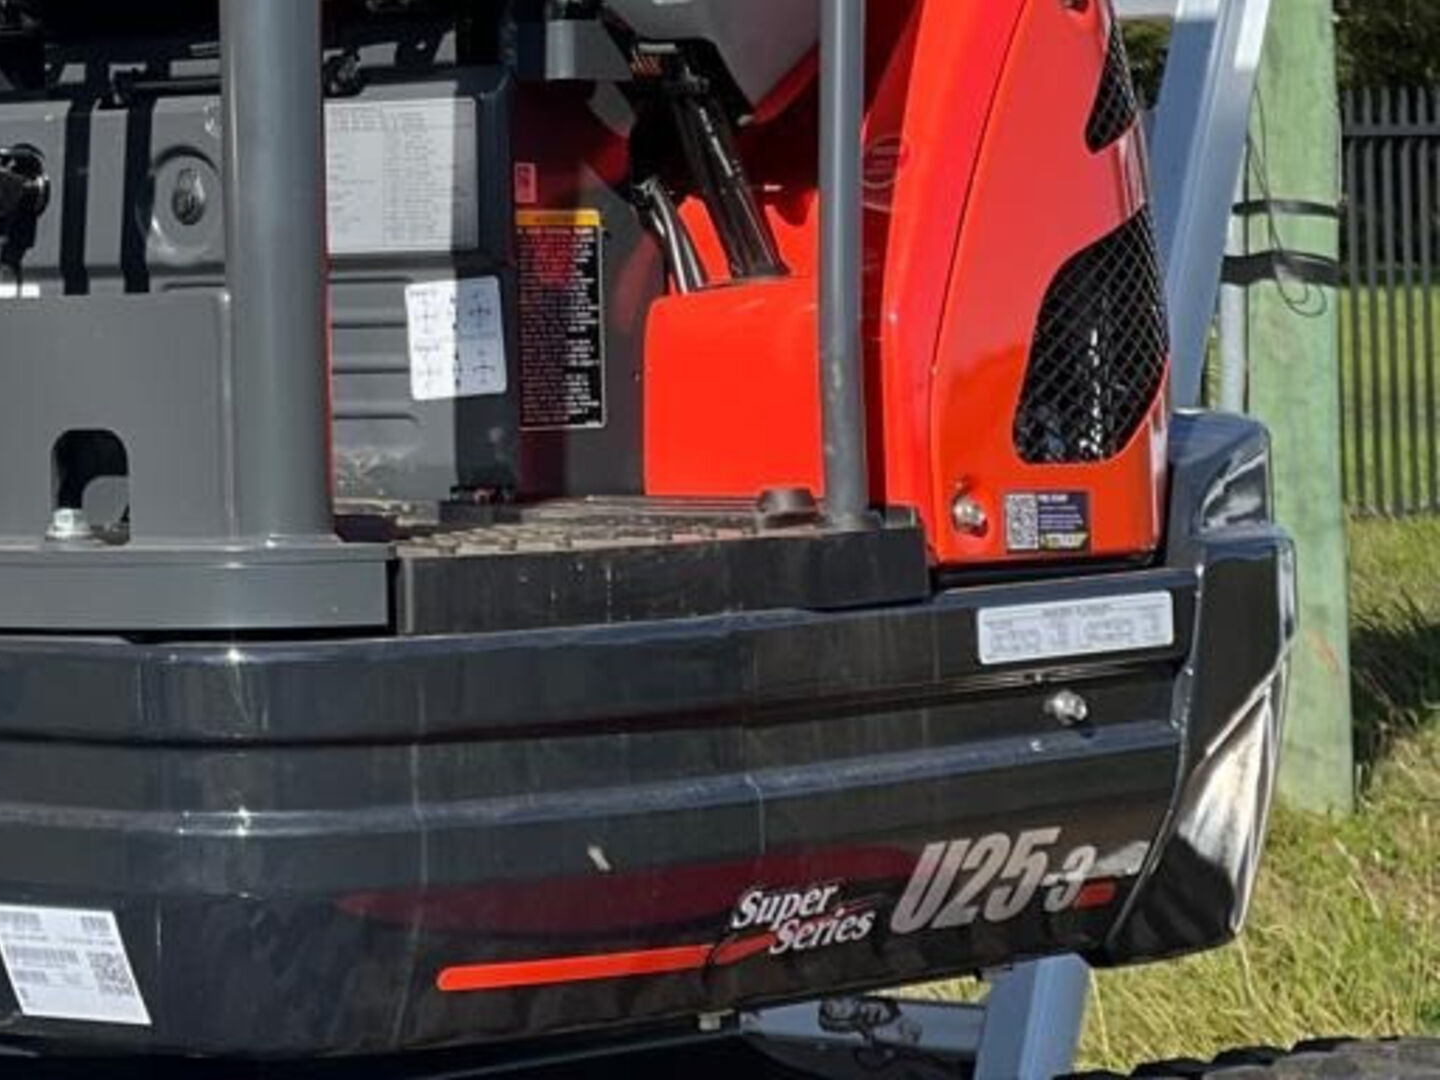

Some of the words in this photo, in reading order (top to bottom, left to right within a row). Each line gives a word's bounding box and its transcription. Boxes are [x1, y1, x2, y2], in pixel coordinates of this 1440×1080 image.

[890, 826, 1097, 934] U25-3
[731, 882, 838, 931] Super
[770, 907, 876, 955] Series
